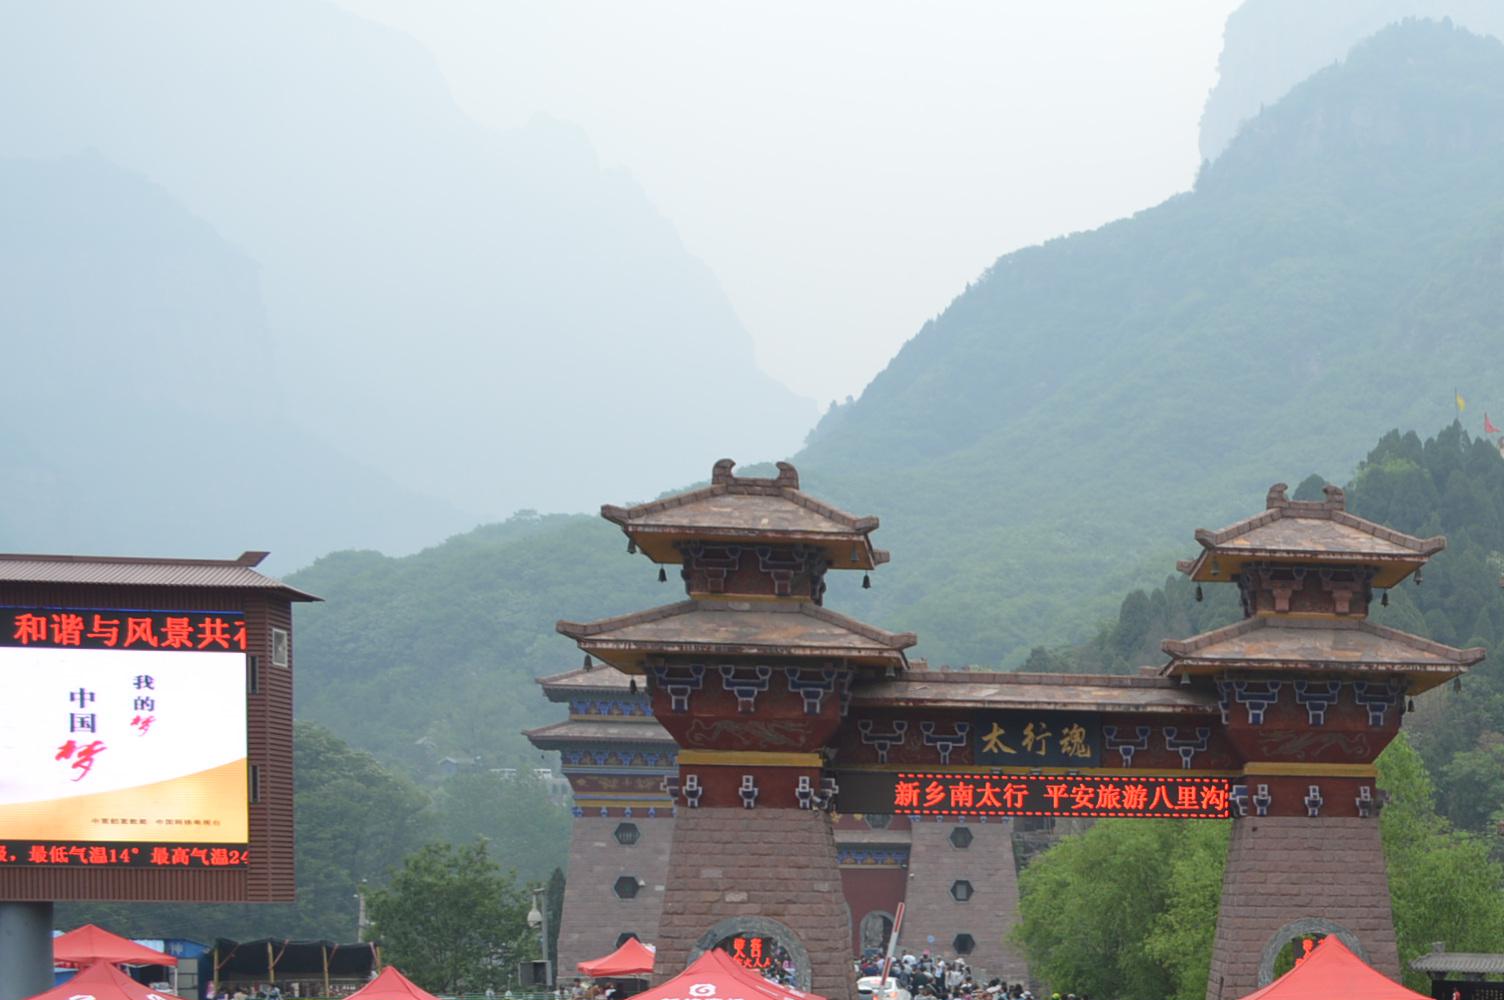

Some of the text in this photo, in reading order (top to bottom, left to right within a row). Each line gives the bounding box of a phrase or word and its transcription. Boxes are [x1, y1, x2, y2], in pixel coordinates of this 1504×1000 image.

[130, 674, 157, 737] 我的梦
[55, 687, 108, 782] 中国梦
[981, 722, 1091, 758] 太行魂
[894, 781, 1226, 811] 新乡南太行 平安旅游八里沟
